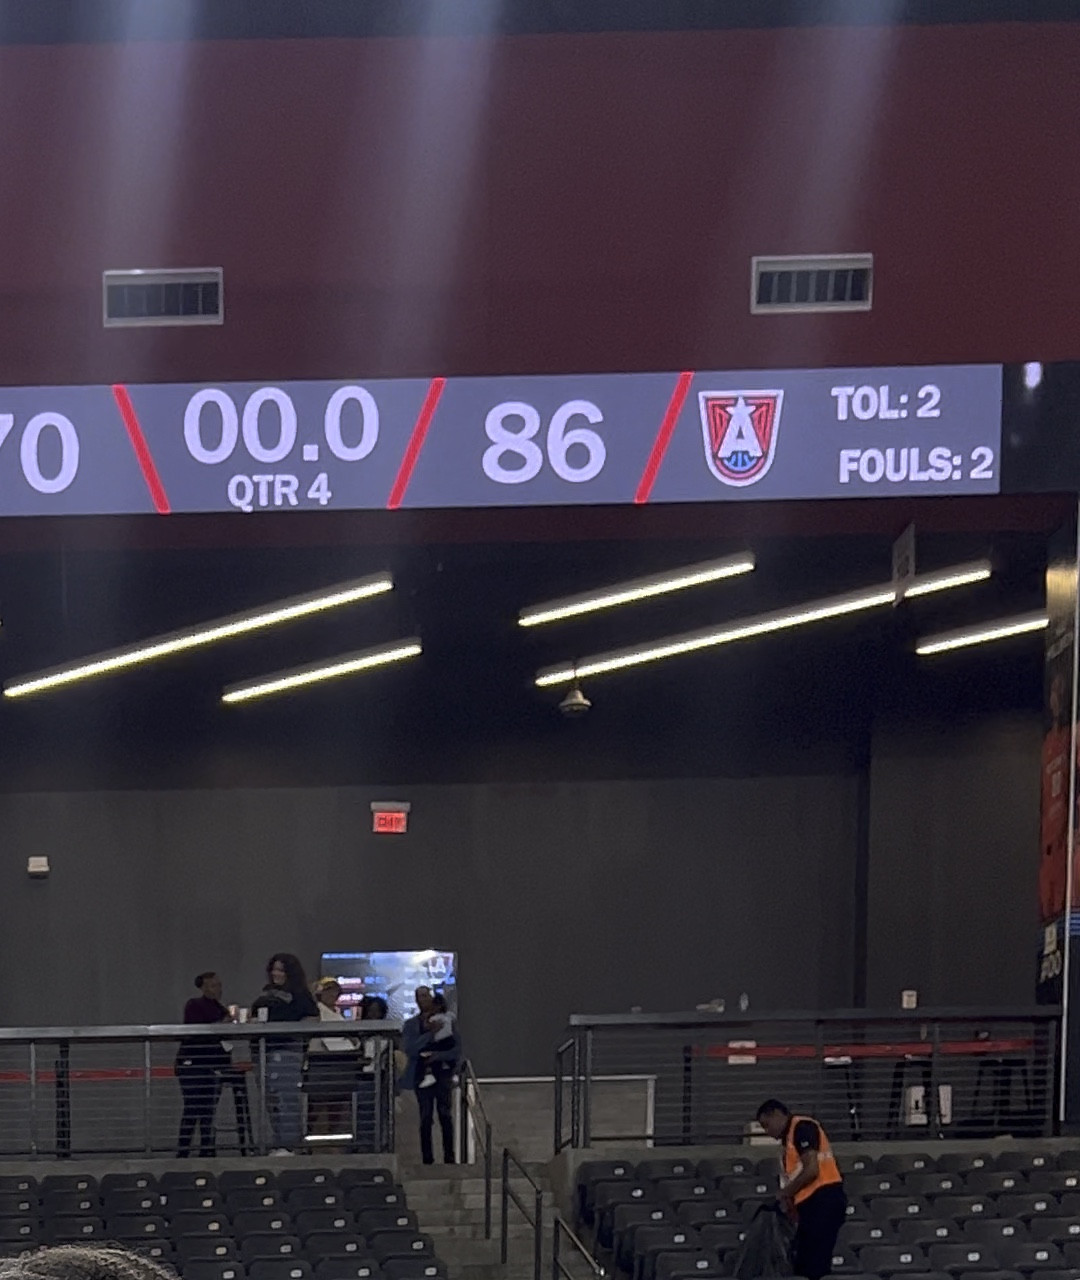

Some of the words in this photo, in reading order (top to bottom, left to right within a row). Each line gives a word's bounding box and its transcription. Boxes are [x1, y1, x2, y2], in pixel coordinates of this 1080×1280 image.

[831, 385, 909, 421] TOL:
[915, 384, 941, 418] 2
[183, 385, 380, 465] 00.0
[480, 398, 608, 485] 86
[838, 447, 962, 484] FOULS:
[969, 446, 995, 480] 2
[227, 474, 300, 512] QTR
[307, 473, 332, 507] 4
